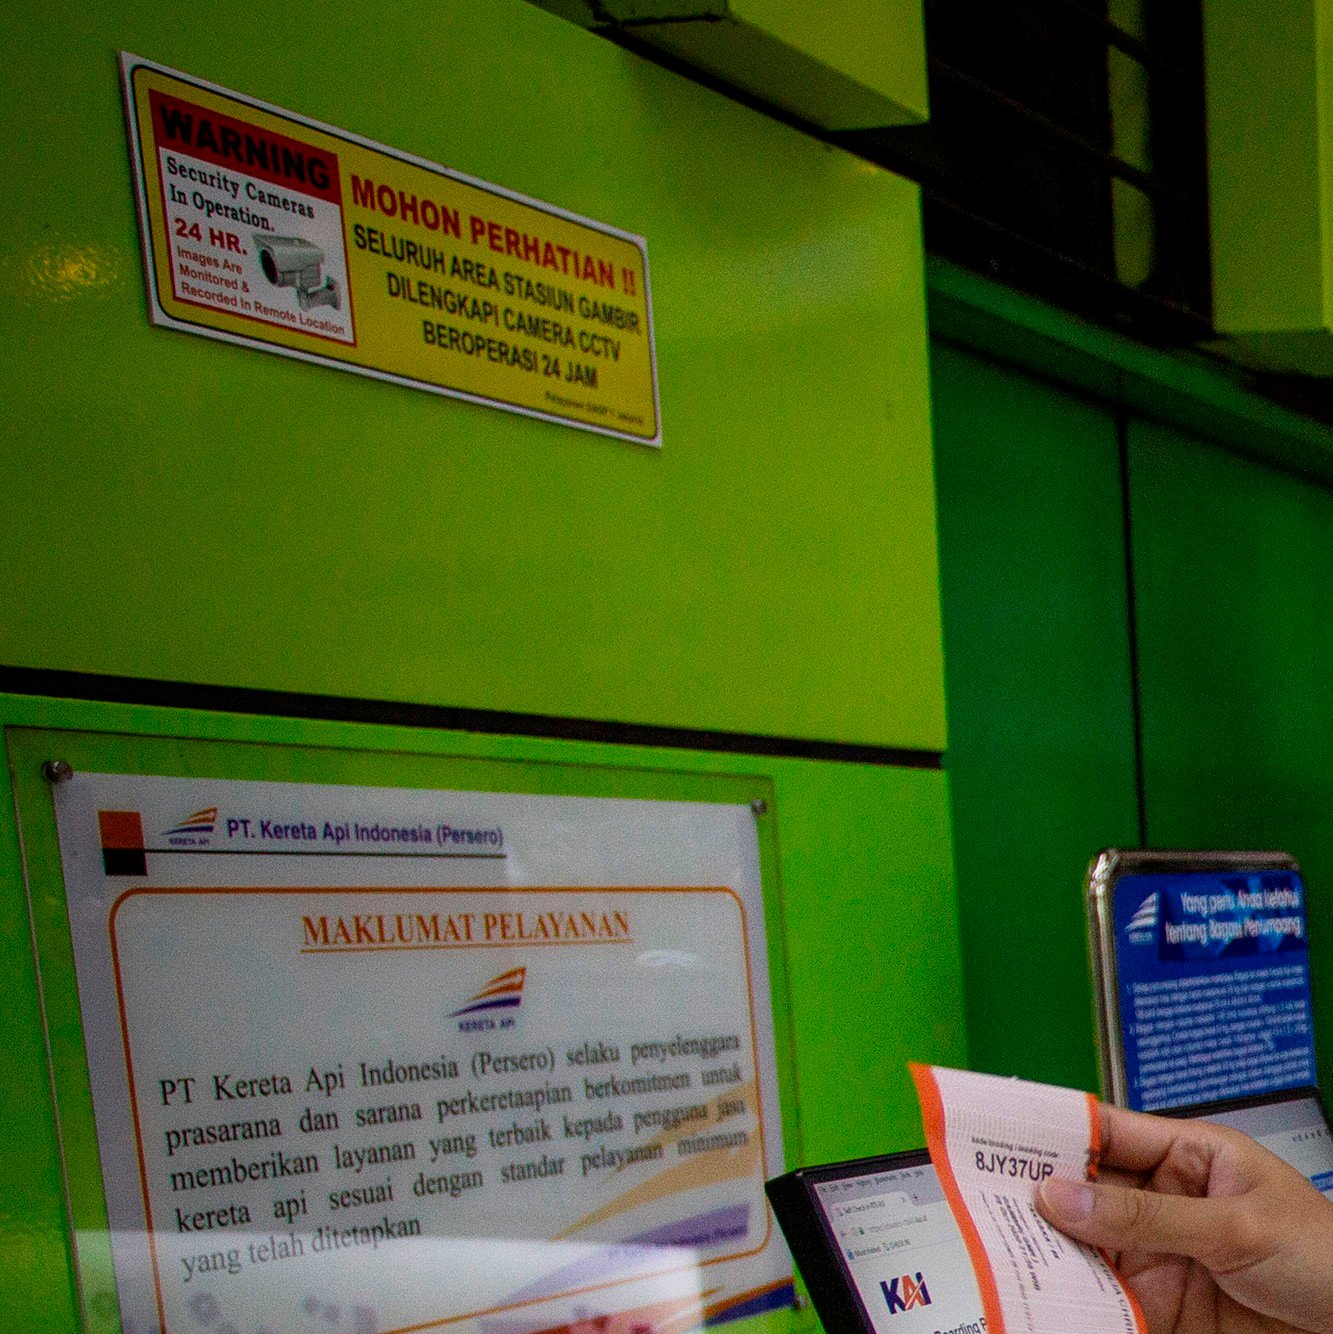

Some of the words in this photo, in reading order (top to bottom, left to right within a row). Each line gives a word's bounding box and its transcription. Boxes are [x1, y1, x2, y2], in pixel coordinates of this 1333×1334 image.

[159, 105, 329, 190] WARNING
[167, 156, 239, 199] Security
[246, 183, 315, 218] Cameras
[170, 184, 187, 205] In
[193, 192, 275, 232] Operation.
[175, 217, 202, 241] 24
[209, 226, 248, 255] HR.
[177, 246, 219, 269] Images
[222, 258, 243, 274] Are
[351, 175, 461, 238] MOHON
[469, 215, 615, 289] PERHATIAN
[179, 264, 238, 291] Monitored
[241, 280, 250, 294] &
[181, 281, 238, 308] Recorded
[254, 300, 296, 323] Remote
[299, 311, 345, 335] Location
[353, 223, 446, 274] SELURUH
[451, 254, 499, 291] AREA
[503, 271, 575, 314] STASIUN
[579, 296, 640, 335] GAMBIR
[386, 272, 498, 326] DILENGKAPI
[503, 307, 576, 350] CAMERA
[579, 329, 620, 362] CCTV
[422, 320, 539, 374] BEROPERASI
[541, 353, 560, 378] 24
[565, 361, 598, 388] JAM
[227, 818, 256, 840] PT.
[261, 819, 317, 842] Kereta
[322, 821, 351, 845] Api
[354, 822, 433, 845] Indonesia
[436, 823, 504, 847] (Persero)
[302, 913, 475, 946] MAKLUMAT
[482, 911, 630, 941] PELAYANAN
[458, 1019, 496, 1033] KERETA
[499, 1017, 516, 1030] API
[159, 1077, 196, 1105] PT
[212, 1074, 293, 1101] Kereta
[304, 1063, 346, 1097] Api
[359, 1054, 459, 1088] Indonesia
[471, 1047, 556, 1080] (Persero)
[566, 1042, 621, 1068] selaku
[630, 1034, 740, 1065] penyelenggara
[164, 1118, 282, 1156] prasarana
[299, 1107, 340, 1134] dan
[355, 1102, 423, 1128] sarana
[436, 1084, 573, 1123] perkeretaapian
[583, 1071, 691, 1101] berkomitmen
[701, 1062, 743, 1087] untuk
[170, 1152, 319, 1192] memberikan
[334, 1140, 416, 1173] layanan
[428, 1135, 478, 1163] yang
[488, 1112, 552, 1147] terbaik
[563, 1111, 623, 1141] kepada
[632, 1102, 708, 1134] pengguna
[716, 1098, 746, 1122] jasa
[975, 1150, 1054, 1182] 8JY37UR
[175, 1203, 251, 1233] kereta
[273, 1190, 308, 1224] api
[328, 1177, 394, 1210] sesuai
[412, 1171, 483, 1198] dengan
[500, 1153, 566, 1184] standar
[580, 1142, 664, 1176] pelayanan
[676, 1130, 748, 1155] minimum
[181, 1249, 243, 1282] yang
[249, 1233, 305, 1264] telah
[311, 1215, 422, 1254] ditetapkan
[879, 1271, 932, 1315] KAI
